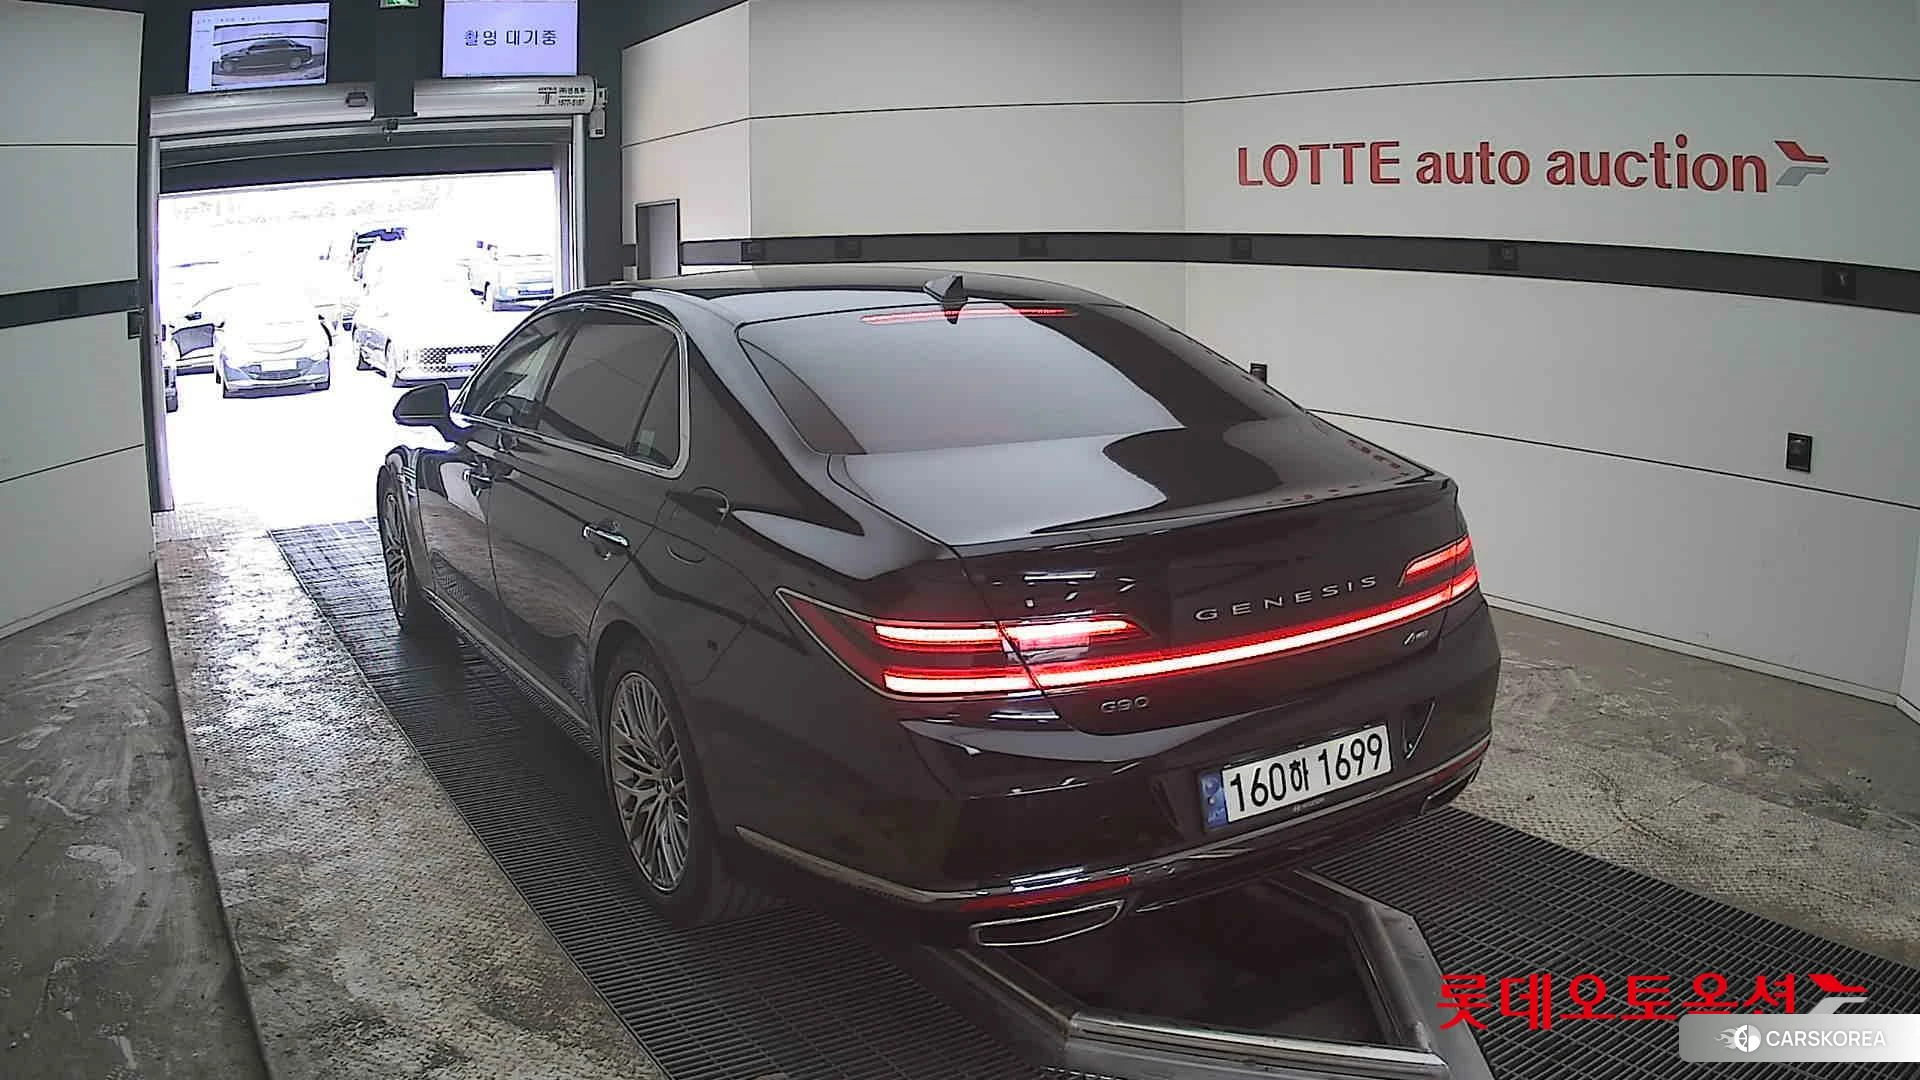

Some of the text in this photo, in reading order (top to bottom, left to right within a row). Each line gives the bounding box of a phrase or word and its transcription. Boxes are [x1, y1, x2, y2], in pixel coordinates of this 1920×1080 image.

[505, 29, 557, 46] 대기중
[1237, 134, 1768, 193] LOTTE auto auction
[1195, 575, 1378, 621] GENESIS
[1100, 696, 1149, 713] G90
[1229, 733, 1383, 812] 160하 1699
